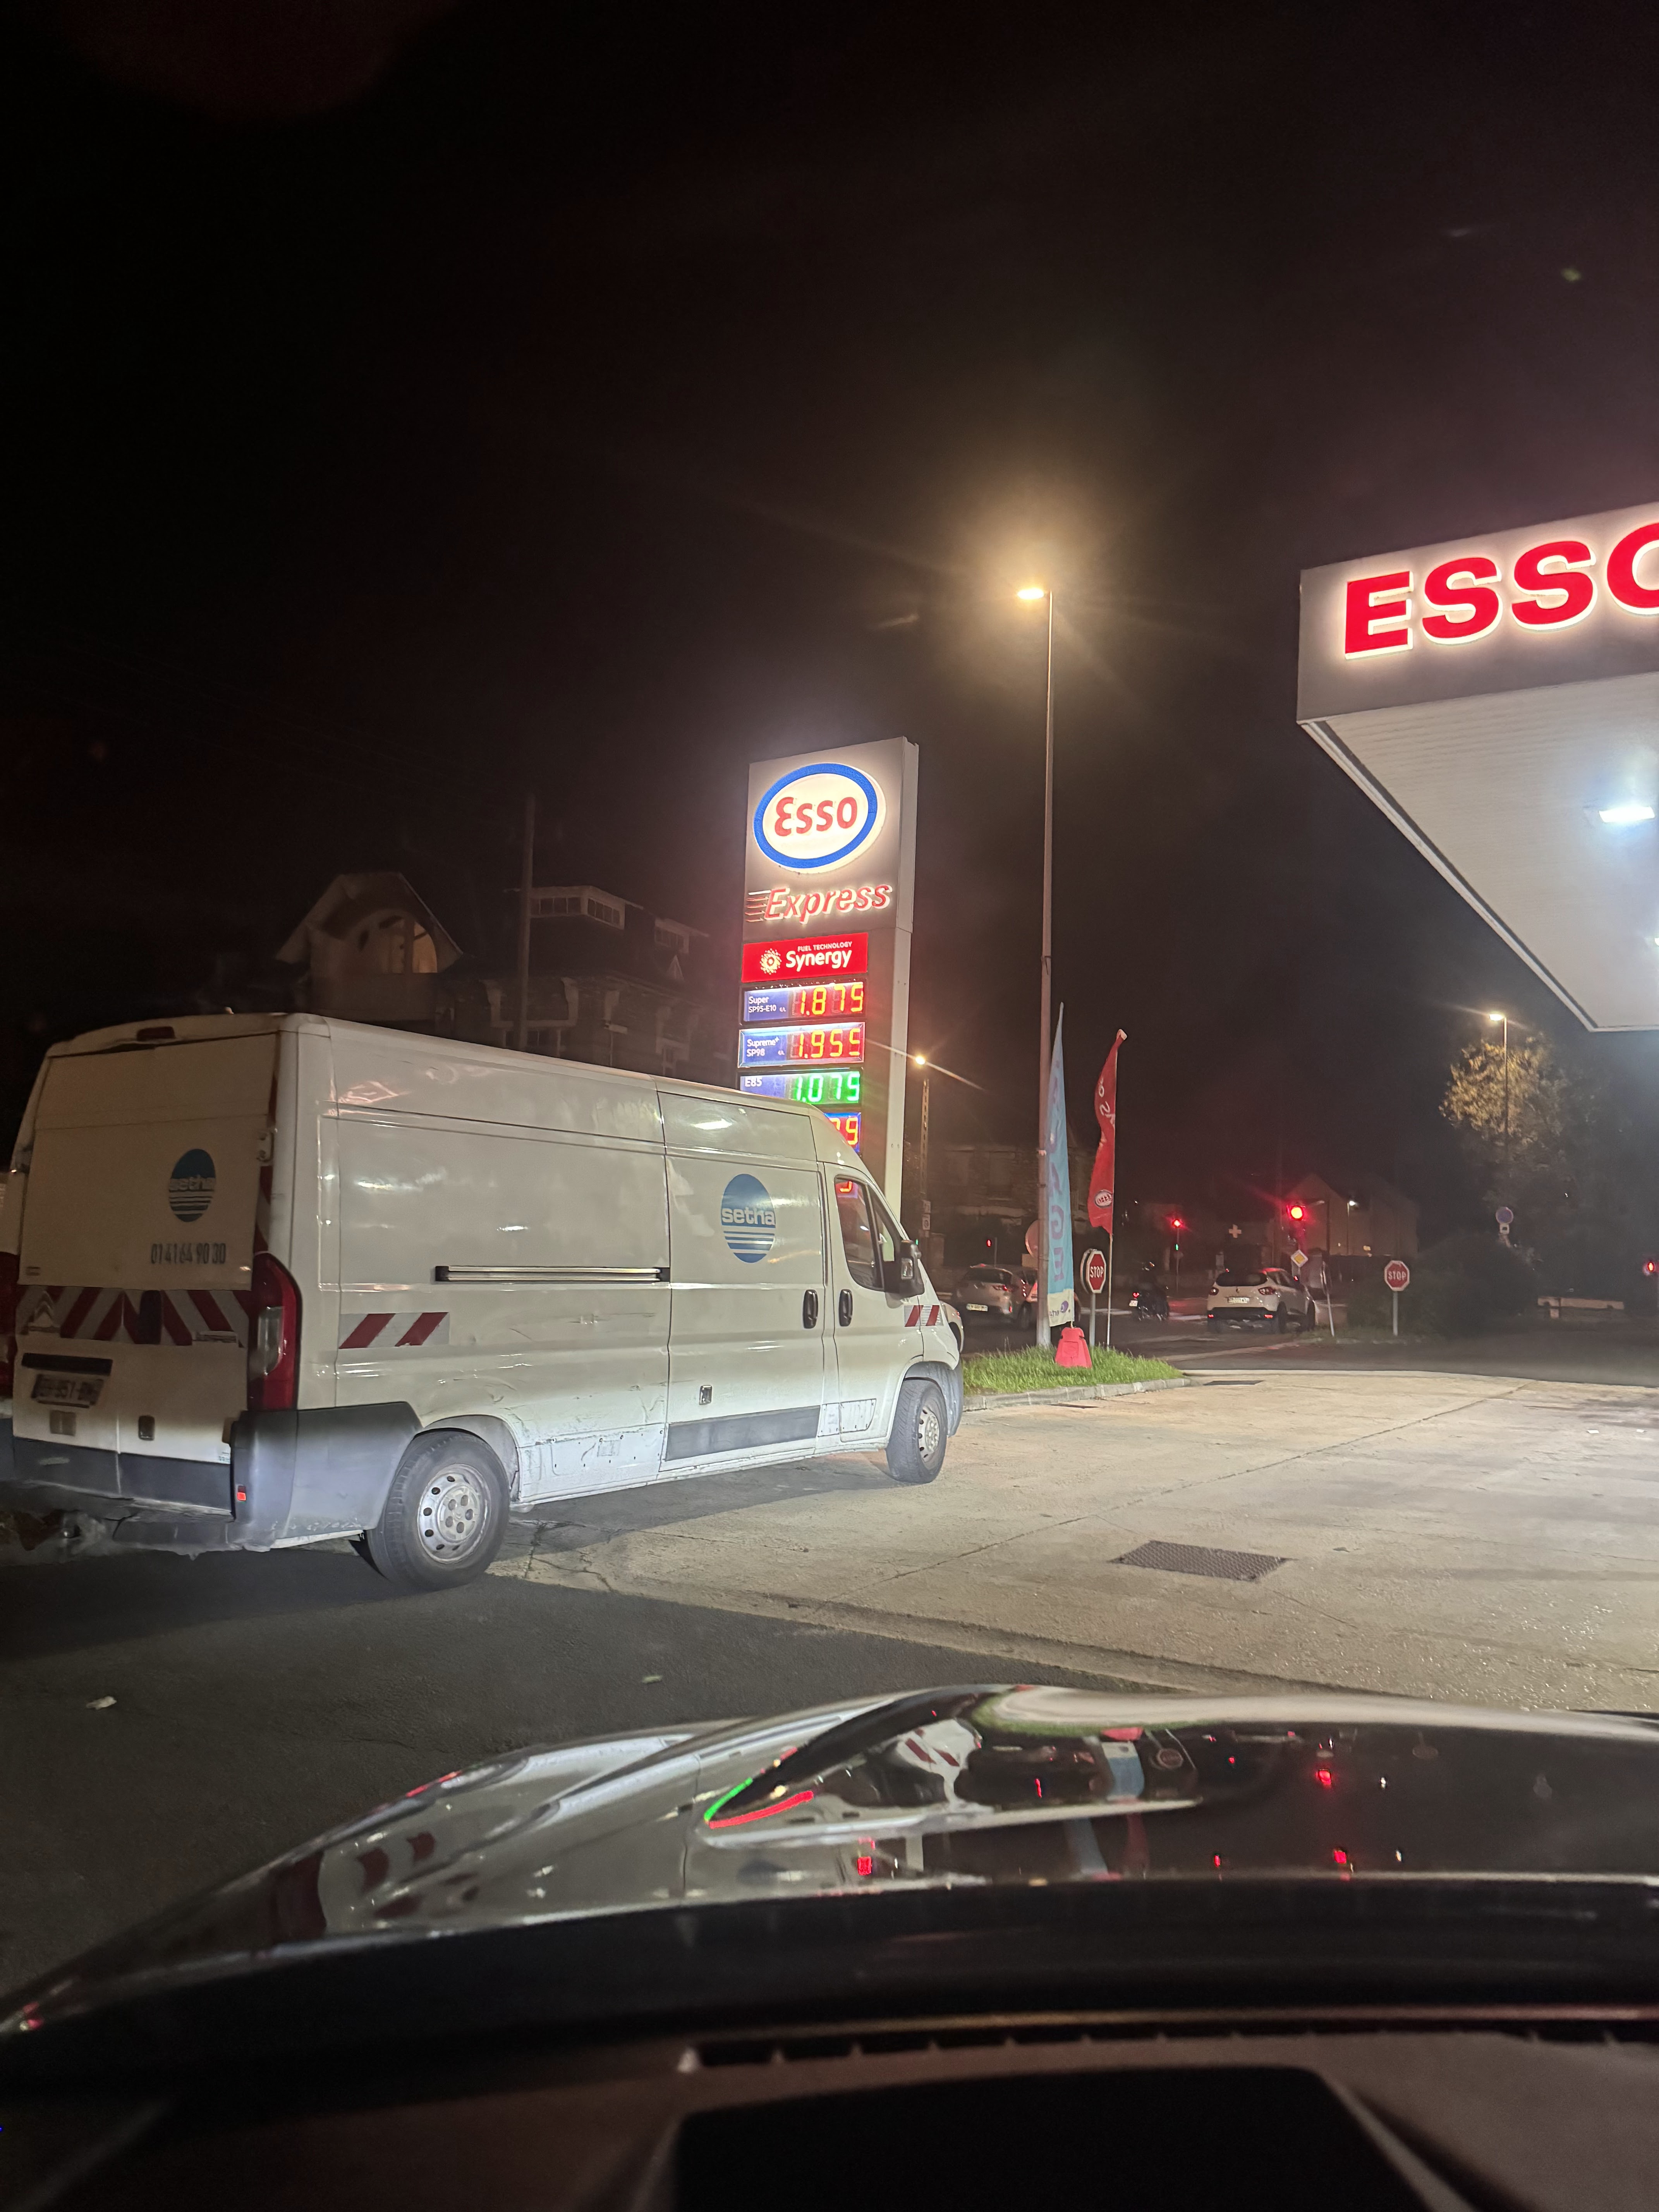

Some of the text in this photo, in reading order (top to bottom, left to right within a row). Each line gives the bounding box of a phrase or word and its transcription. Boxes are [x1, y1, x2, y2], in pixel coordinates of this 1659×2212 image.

[764, 884, 892, 924] Express
[813, 941, 852, 951] TECHNOLOGY
[786, 950, 852, 972] Synergy
[749, 996, 769, 1005] Super
[748, 1005, 776, 1013] SP95-E10
[747, 1048, 765, 1057] SP98
[745, 1076, 763, 1087] E85
[722, 1207, 775, 1226] setha
[1090, 1266, 1104, 1278] STOP
[1388, 1271, 1407, 1281] STOP
